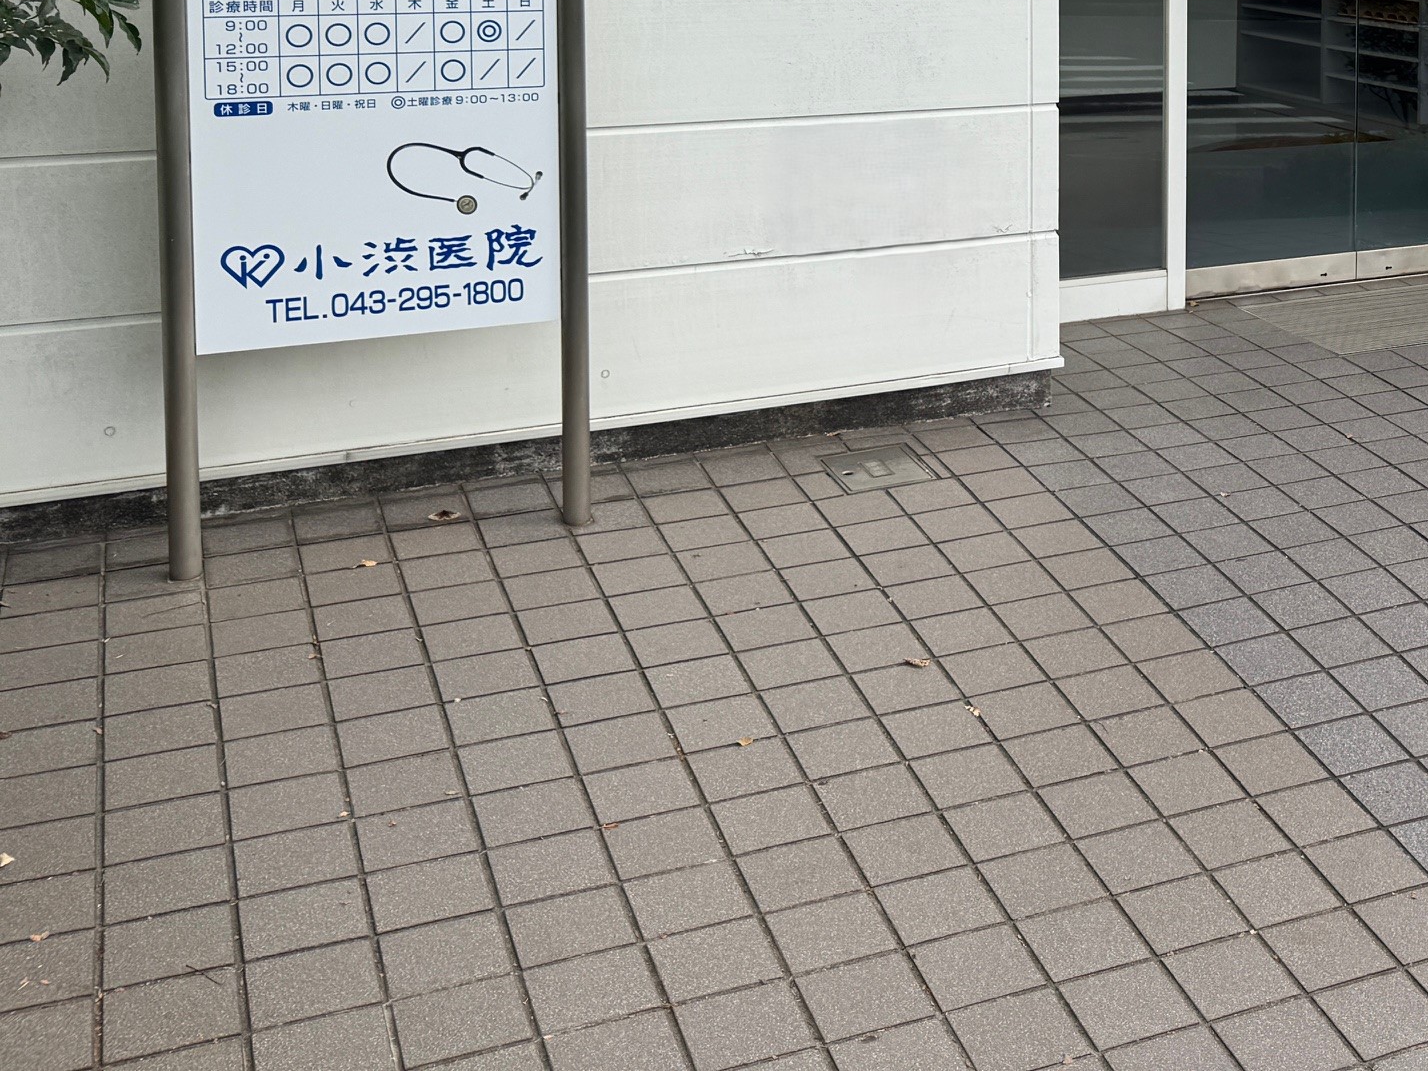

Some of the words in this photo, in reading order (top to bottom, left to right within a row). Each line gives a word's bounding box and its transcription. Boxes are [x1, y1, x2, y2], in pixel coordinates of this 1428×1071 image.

[209, 0, 274, 13] 診療時間
[292, 0, 305, 13] 月
[225, 19, 268, 32] 9:00
[215, 42, 268, 55] 12:00
[216, 60, 269, 73] 15:00
[216, 82, 269, 96] 18:00
[219, 102, 268, 116] 休診日
[287, 98, 377, 112] 木曜・日曜・祝日
[293, 224, 544, 280] 小渋医院
[265, 278, 525, 323] TEL.043-295-1800
